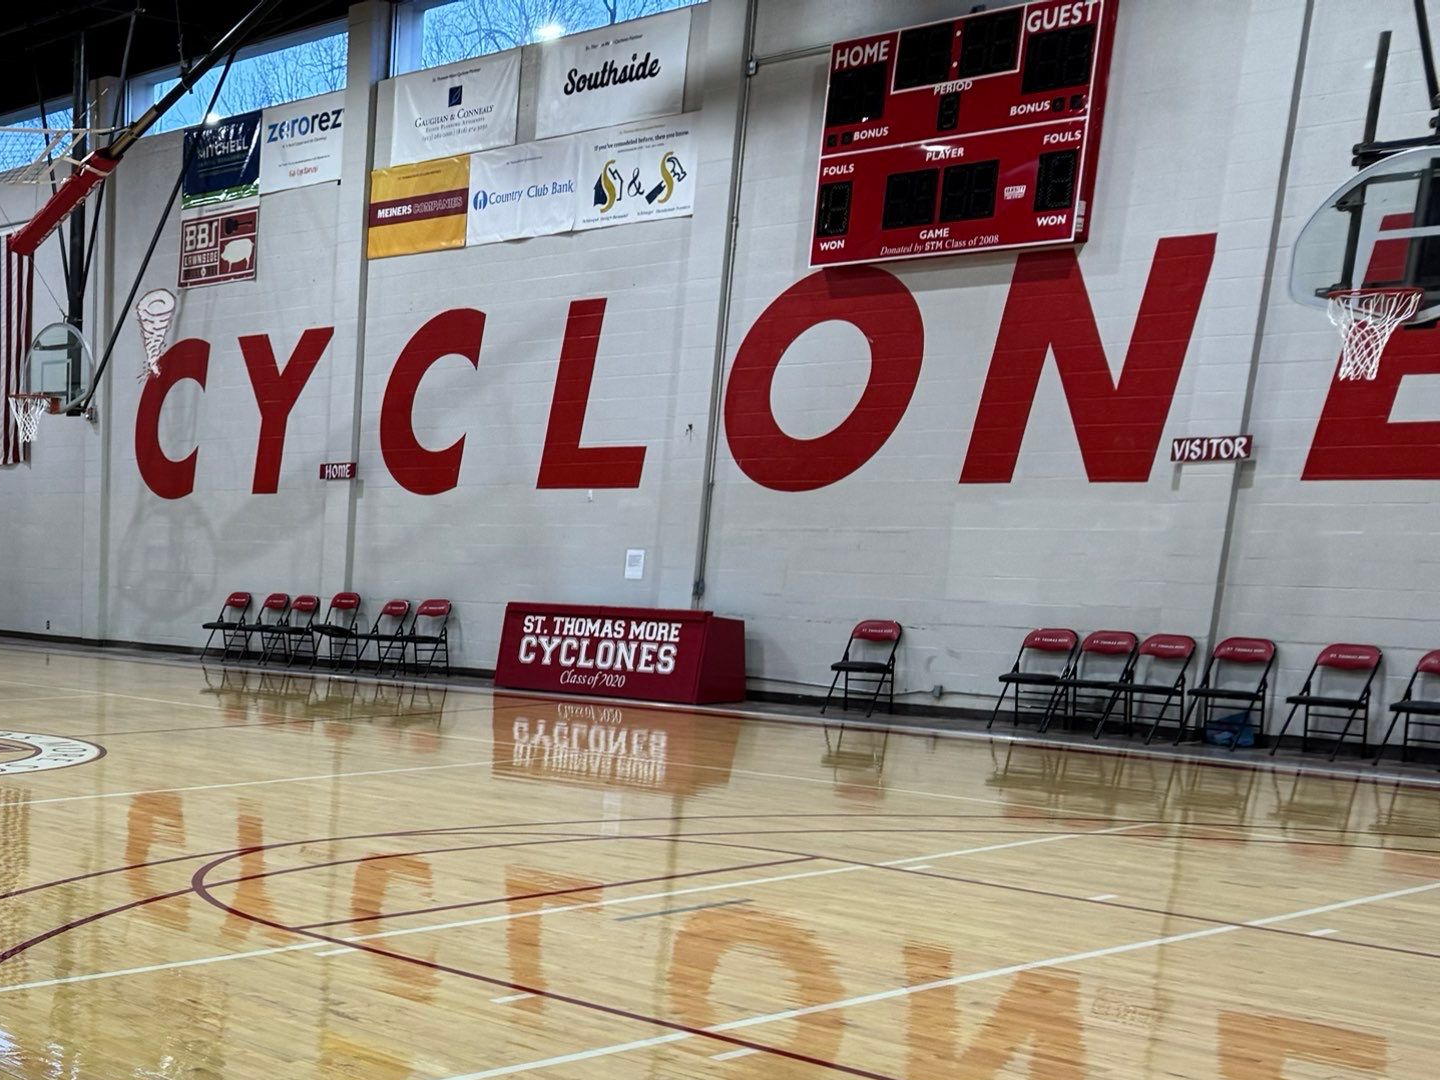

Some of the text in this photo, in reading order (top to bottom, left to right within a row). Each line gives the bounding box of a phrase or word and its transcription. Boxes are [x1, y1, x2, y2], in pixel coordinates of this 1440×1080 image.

[1027, 1, 1099, 33] GUEST
[835, 40, 890, 70] HOME
[563, 52, 661, 95] Southside
[933, 81, 973, 96] PERIOD
[1010, 101, 1050, 116] BONUS
[267, 108, 342, 143] zerorez
[853, 126, 889, 141] BONUS
[197, 137, 249, 160] MITCHELL
[1043, 130, 1082, 145] FOULS
[926, 147, 965, 162] PLAYER
[823, 164, 855, 177] FOULS
[489, 180, 574, 206] Country Club Bank
[627, 167, 645, 198] &
[377, 196, 463, 219] MEINERS COMPANIES
[1037, 215, 1067, 227] WON
[820, 239, 845, 251] WON
[880, 234, 999, 256] Donated by STM Class of 2008
[919, 228, 950, 240] GAME
[1173, 436, 1247, 460] VISITOR
[325, 464, 351, 479] HOME
[523, 615, 682, 642] ST. THOMAS MORE
[518, 636, 678, 675] CYCLONES
[560, 671, 626, 688] Class of 2020
